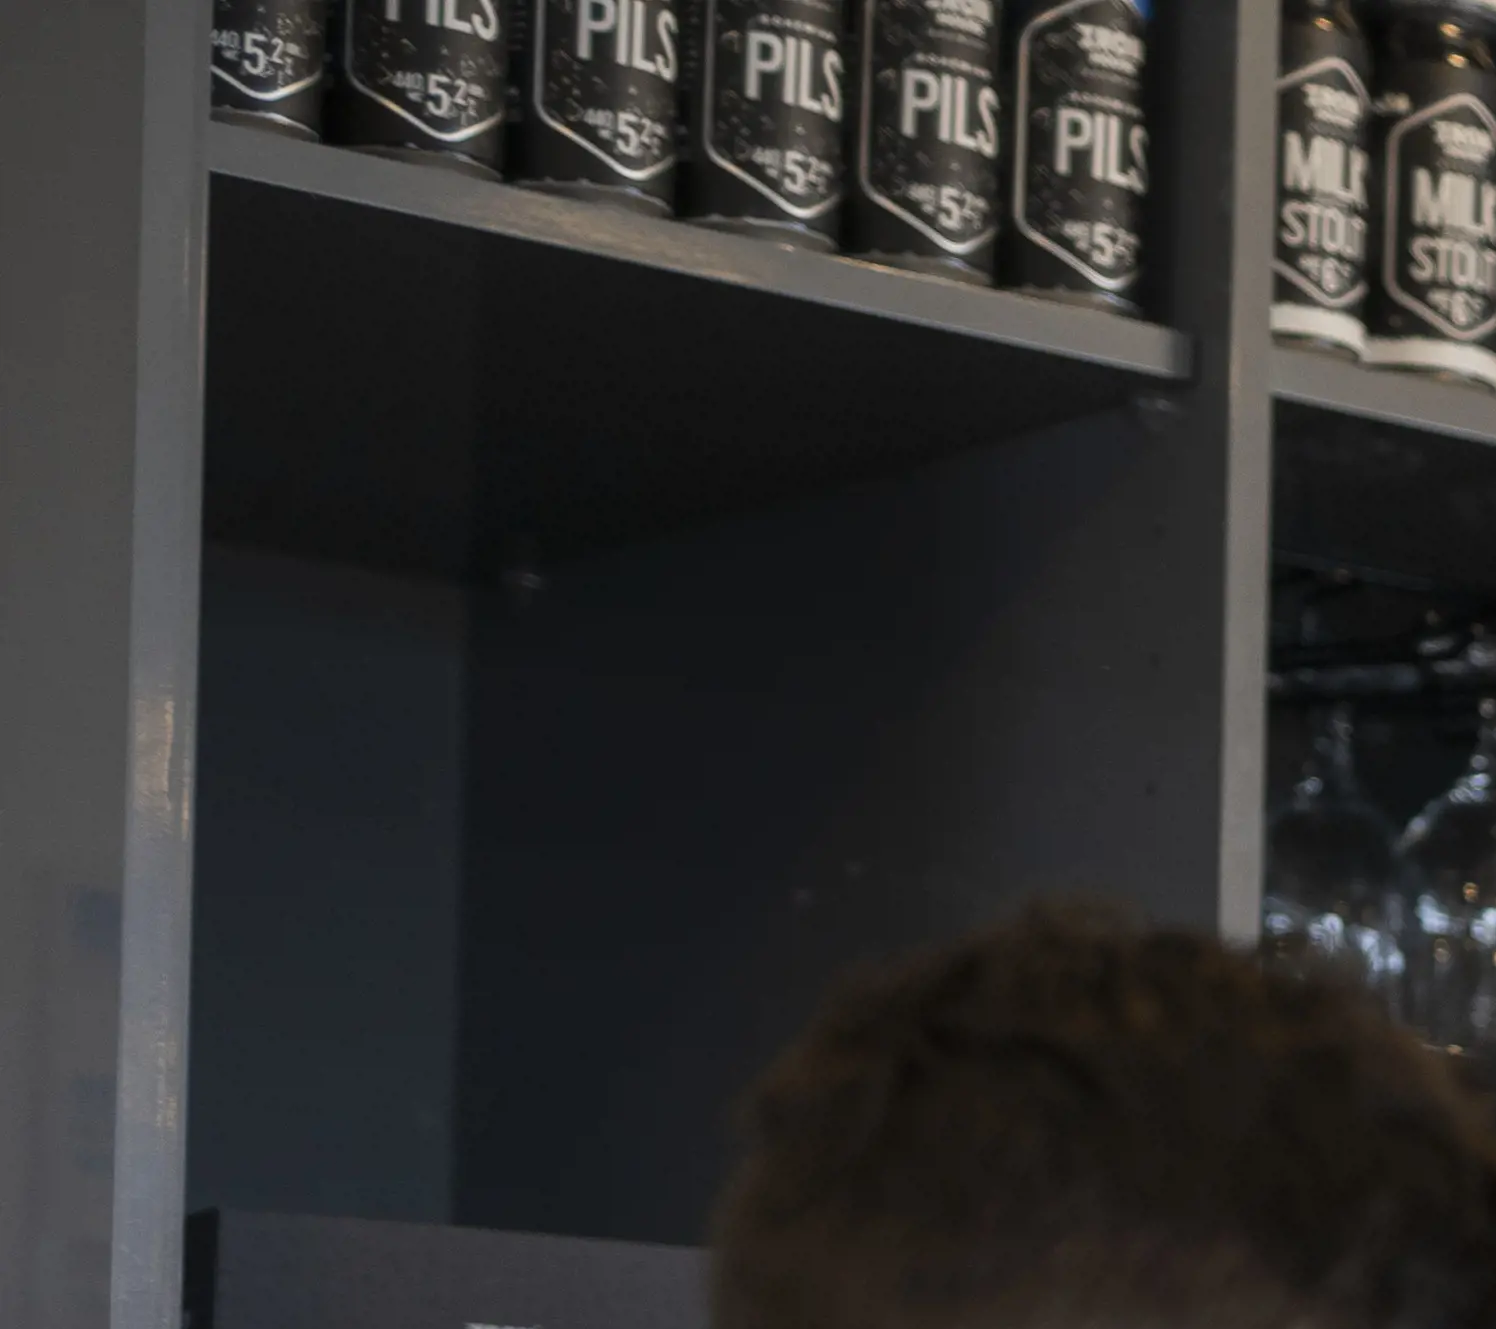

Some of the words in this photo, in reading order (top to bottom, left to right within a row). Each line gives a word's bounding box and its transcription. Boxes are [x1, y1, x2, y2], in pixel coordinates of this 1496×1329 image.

[577, 0, 679, 82] PILS
[745, 31, 843, 121] PILS
[900, 68, 1000, 159] PILS
[1054, 106, 1149, 194] PILS
